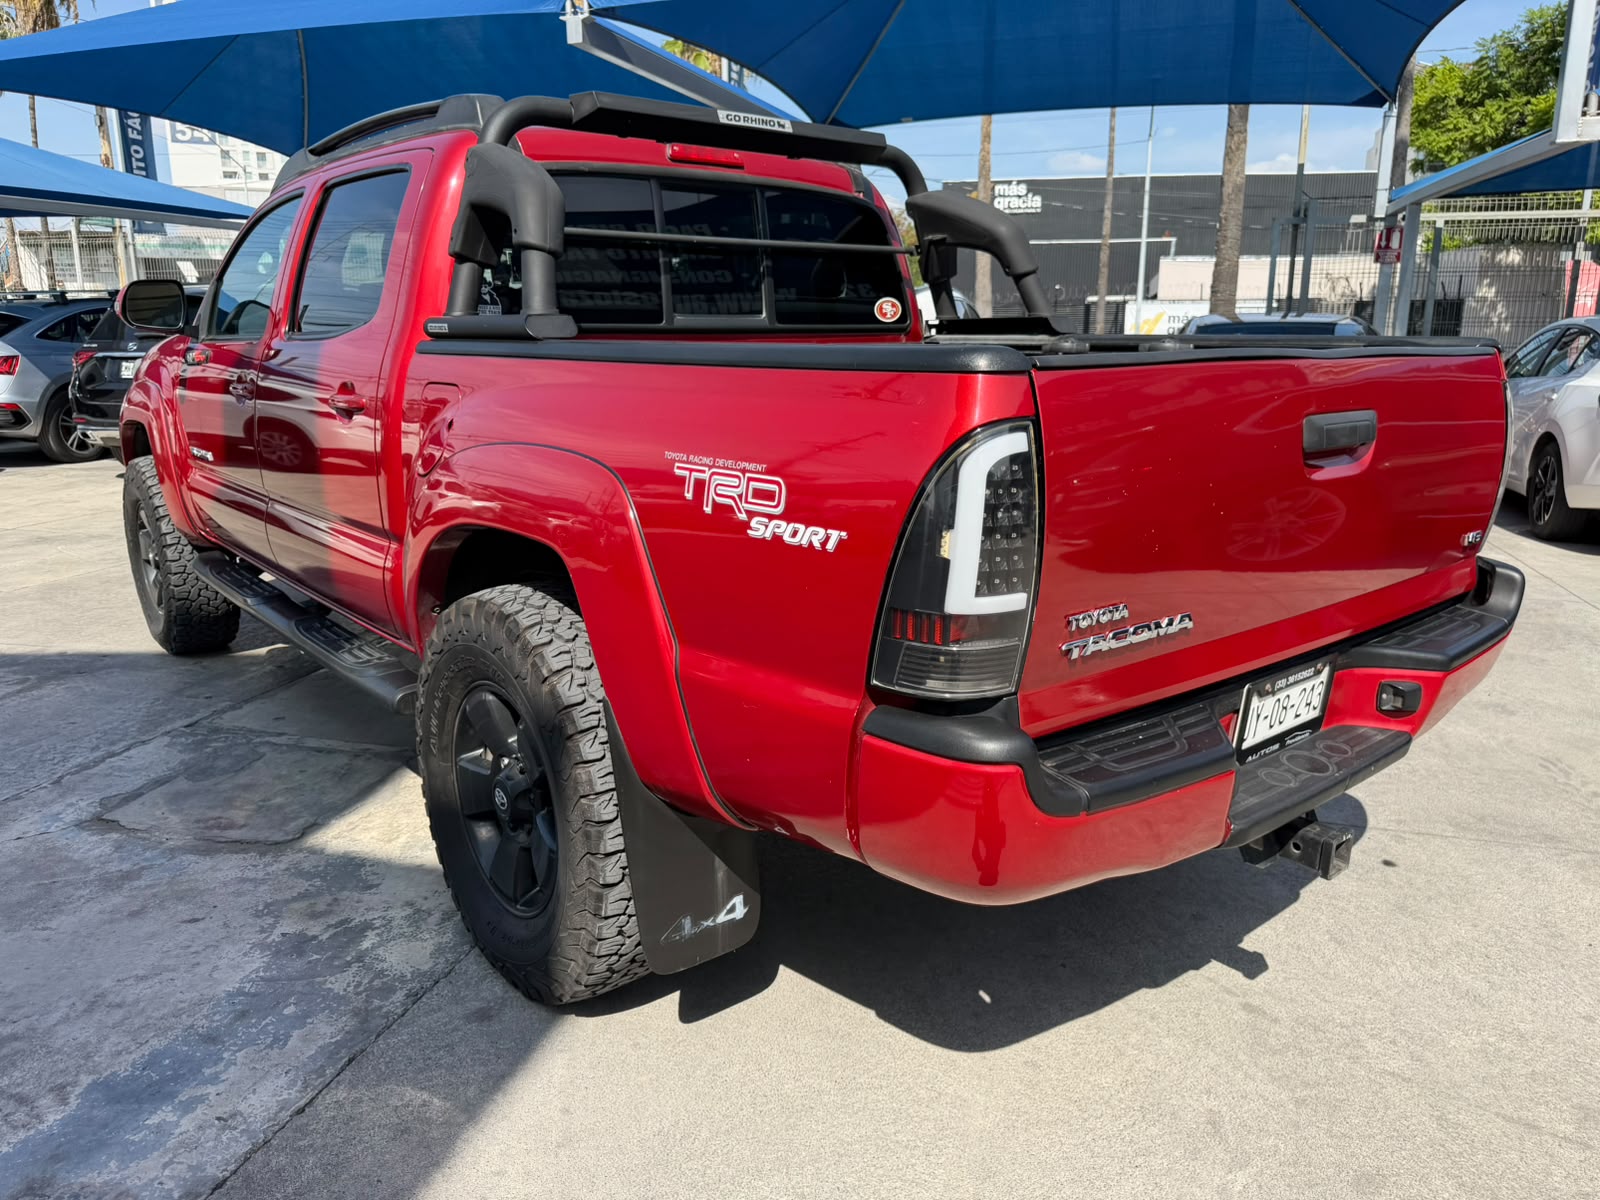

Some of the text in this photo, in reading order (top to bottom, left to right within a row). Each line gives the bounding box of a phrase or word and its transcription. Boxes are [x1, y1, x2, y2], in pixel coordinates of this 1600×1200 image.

[726, 113, 776, 127] GO RHINO
[994, 180, 1027, 197] más
[664, 451, 768, 473] TOYOTA RACING DEVELOPMENT
[673, 462, 787, 521] TRD
[746, 516, 849, 553] SPORT
[1067, 603, 1130, 631] TOYOTA
[1060, 612, 1194, 660] TACOMA
